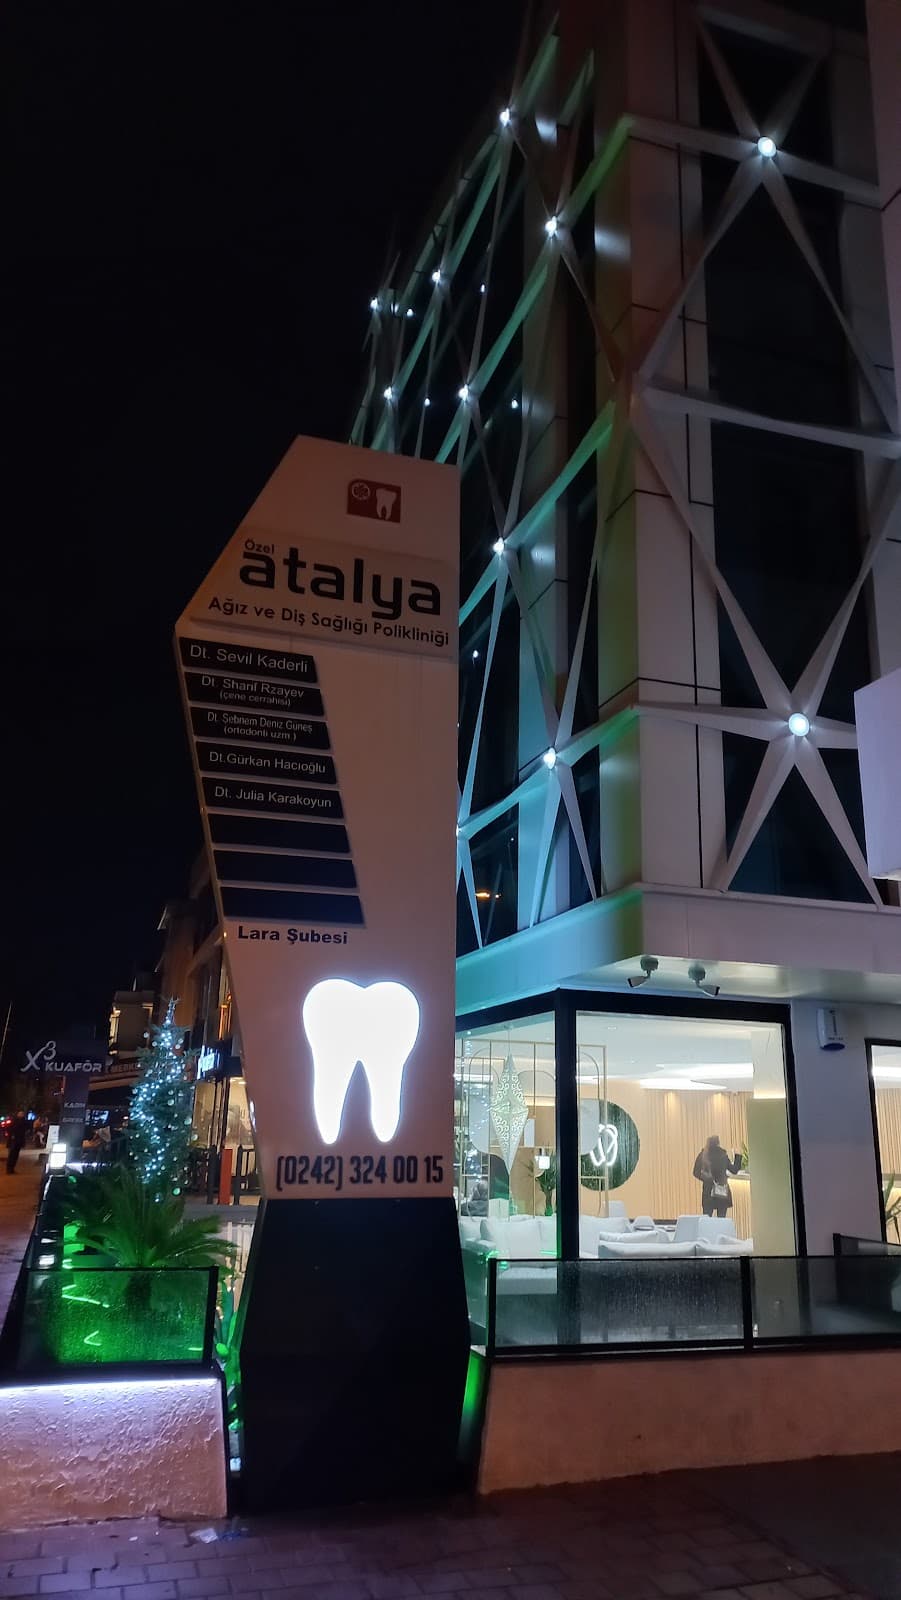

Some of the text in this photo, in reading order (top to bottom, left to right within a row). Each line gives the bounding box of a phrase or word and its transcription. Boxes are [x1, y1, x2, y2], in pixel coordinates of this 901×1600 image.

[244, 538, 275, 554] Özel
[239, 547, 441, 620] atalya
[208, 596, 449, 647] Ağız ve Diş Sağlığı Polikliniği
[190, 644, 308, 673] Dt. Sevil Kaderli
[223, 678, 258, 692] Sharif
[261, 683, 304, 698] Rzayev
[274, 758, 326, 774] Hacıoğlu
[236, 789, 264, 801] Julia
[268, 791, 332, 808] Karakoyun
[238, 926, 348, 945] Lara Şubesi
[45, 1059, 102, 1072] KUAFÖR
[276, 1155, 443, 1191] (0242) 324 00 15
